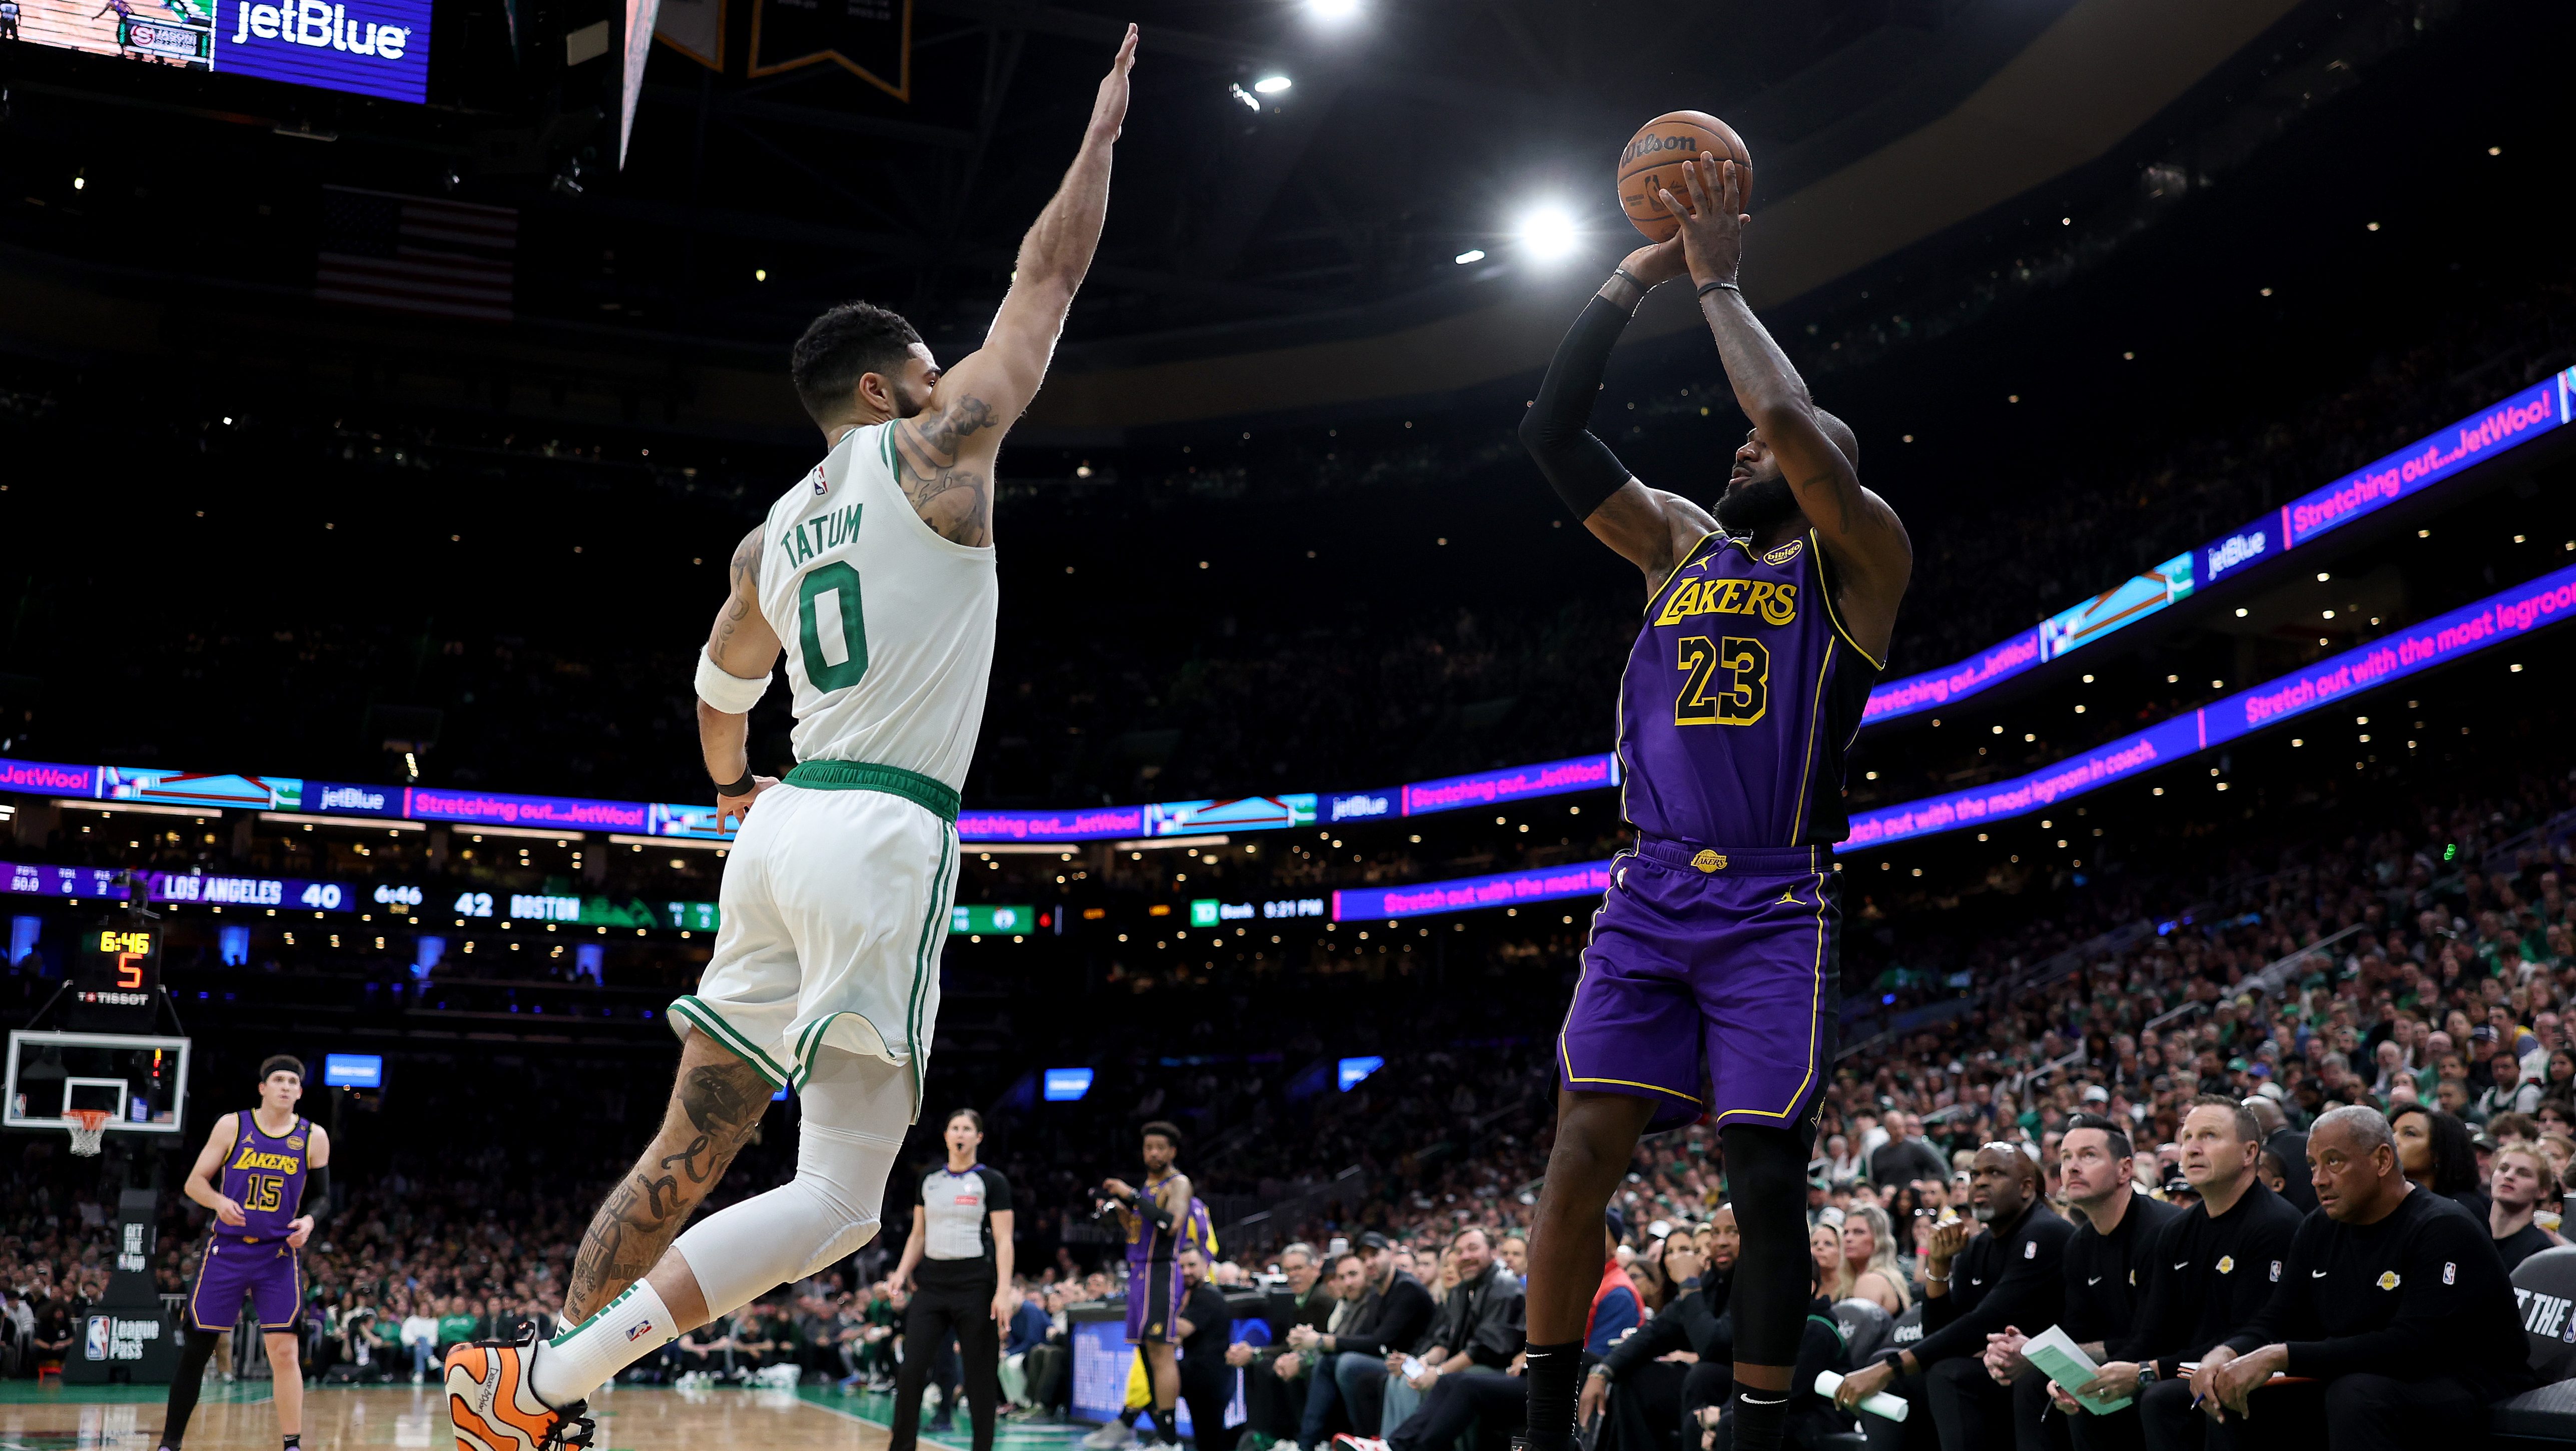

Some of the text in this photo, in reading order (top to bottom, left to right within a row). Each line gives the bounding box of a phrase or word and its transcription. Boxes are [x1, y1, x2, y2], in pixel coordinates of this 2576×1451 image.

[232, 0, 406, 60] jetBlue
[2293, 466, 2400, 532] Stretching
[781, 503, 863, 570] TATUM
[1768, 544, 1800, 559] bibigo
[2208, 531, 2266, 581] jetBlue
[1653, 577, 1797, 627] LAKERS
[799, 560, 869, 694] 0
[1674, 635, 1769, 727] 23
[2245, 678, 2314, 723] Stretch
[2316, 666, 2351, 699] out
[2351, 646, 2398, 682] with
[2399, 633, 2435, 665] the
[2437, 612, 2495, 652] most
[320, 787, 385, 811] jetBlue
[416, 793, 518, 822] Stretching
[1331, 795, 1389, 822] jetBlue
[956, 816, 1027, 838] etching
[164, 875, 342, 909] LOS ANGELES 40
[374, 884, 423, 906] 6:46
[454, 892, 580, 922] 42 BOSTON
[100, 931, 150, 954] 6:46
[117, 952, 143, 988] 5
[232, 1147, 300, 1175] LAKERS
[243, 1173, 284, 1212] 15
[111, 1316, 160, 1343] League
[2524, 1292, 2572, 1338] THE
[109, 1337, 144, 1360] Pass
